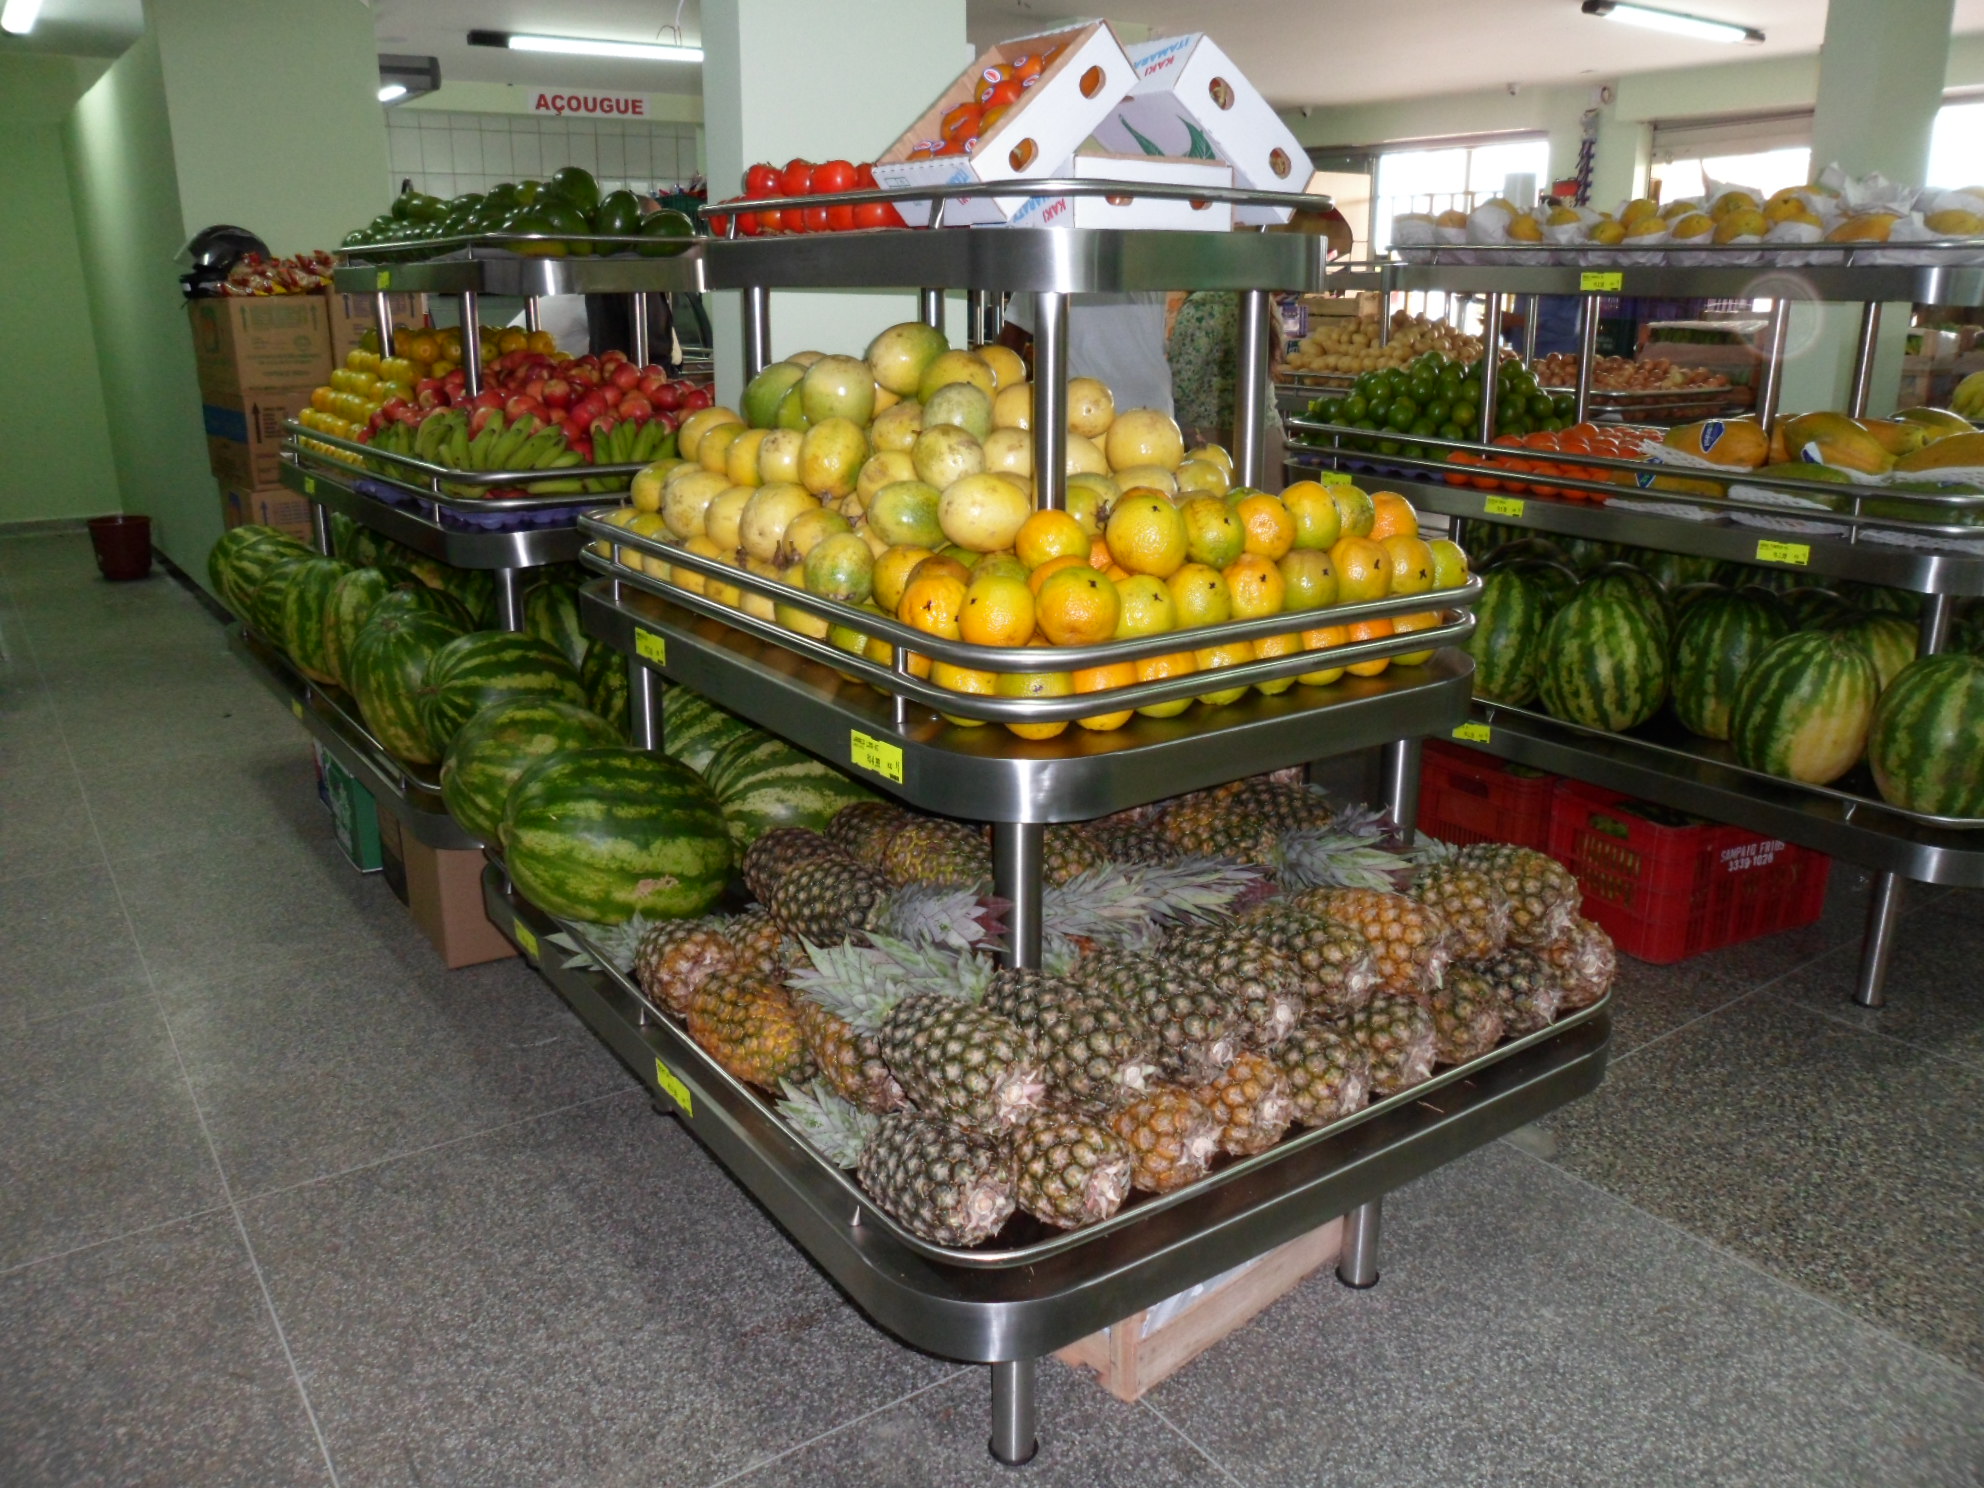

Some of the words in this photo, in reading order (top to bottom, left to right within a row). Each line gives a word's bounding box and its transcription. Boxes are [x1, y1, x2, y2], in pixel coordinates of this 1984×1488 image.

[1145, 55, 1175, 77] KAKI
[535, 93, 644, 116] AÇOUGUE
[1042, 197, 1067, 224] KAKI
